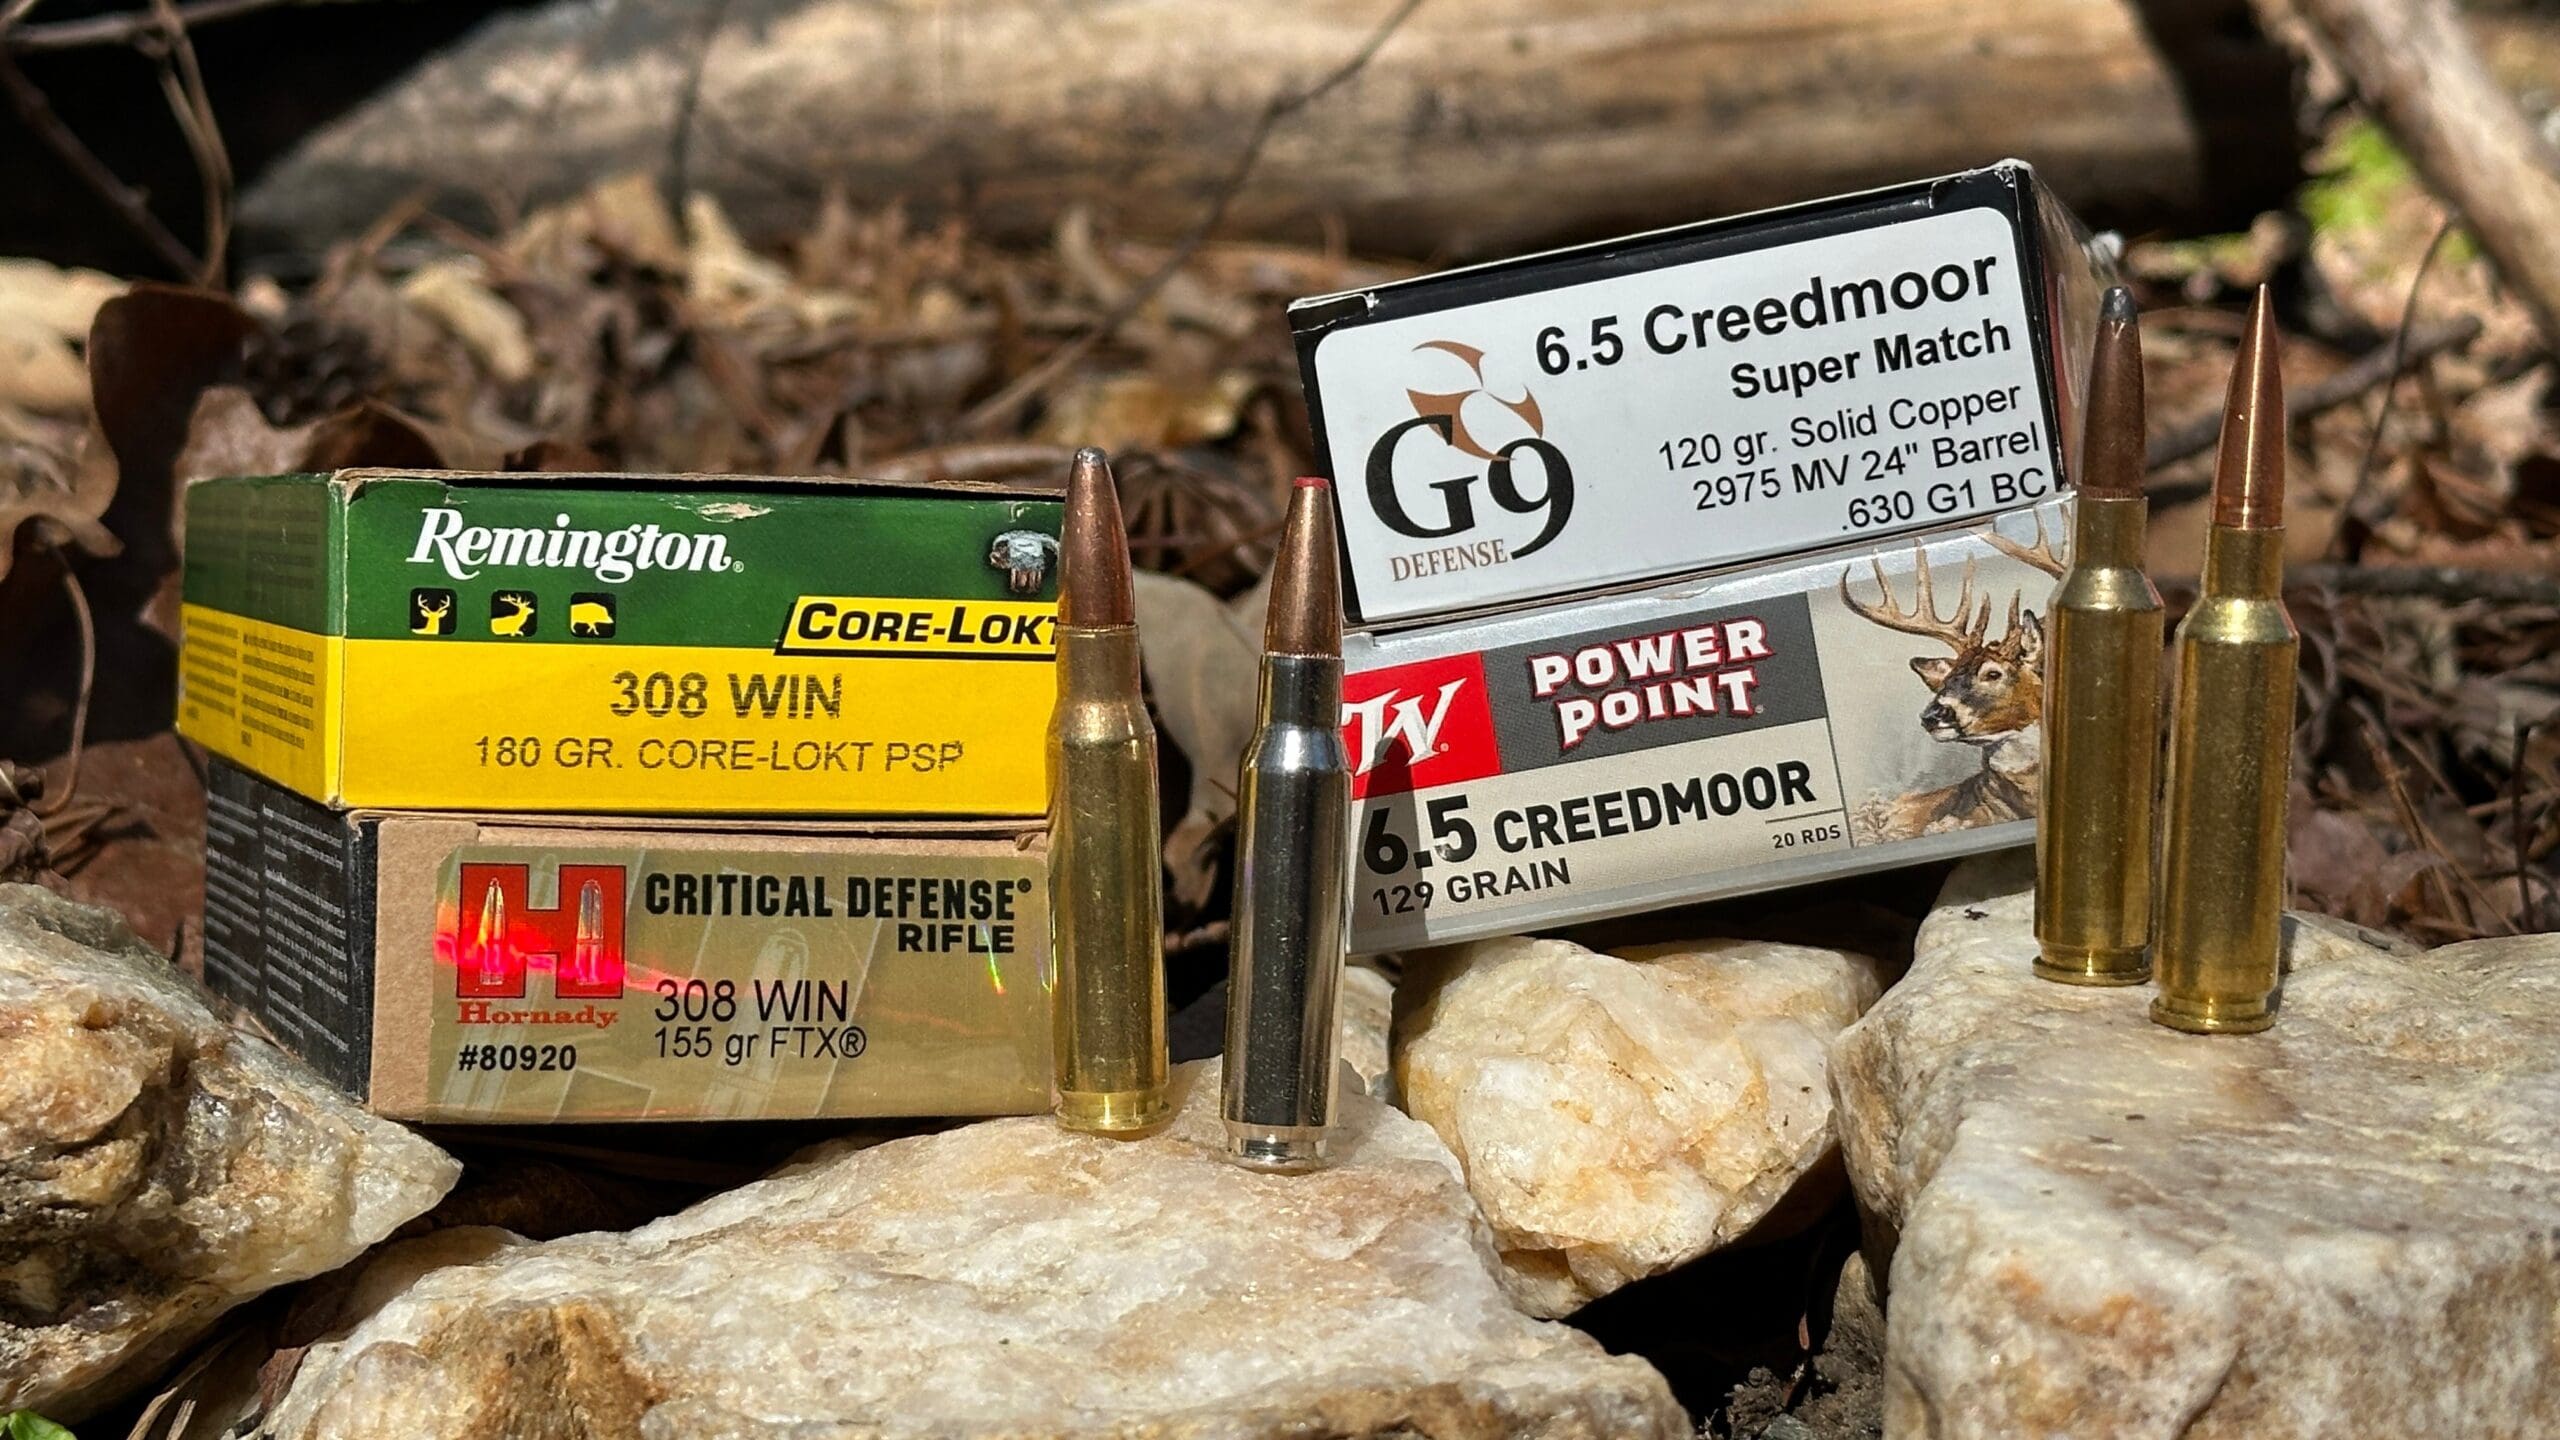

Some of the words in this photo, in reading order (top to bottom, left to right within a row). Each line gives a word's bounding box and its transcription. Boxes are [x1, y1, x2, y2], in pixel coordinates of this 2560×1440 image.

[1535, 315, 1624, 376] 6.5
[1643, 255, 1997, 355] Creedmoor
[1731, 350, 1860, 399] Super
[1873, 318, 2012, 373] Match
[1659, 433, 1721, 471] 120
[1733, 430, 1778, 466] gr.
[1790, 405, 1877, 447] Solid
[1889, 384, 2021, 430] Copper
[1365, 413, 1575, 560] G9
[1693, 468, 1781, 511] 2975
[1792, 455, 1849, 493] MV
[1861, 442, 1918, 481] 24"
[1932, 421, 2040, 468] Barrel
[1841, 491, 1914, 531] .630
[1927, 479, 1975, 514] G1
[1991, 467, 2047, 504] BC
[1390, 538, 1508, 582] DEFENSE
[1528, 616, 1776, 697] POWER
[609, 670, 708, 717] 308
[728, 672, 842, 719] WIN
[1556, 666, 1760, 750] POINT
[475, 735, 541, 768] 180
[553, 738, 623, 769] GR.
[638, 739, 873, 772] CORE-LOKT
[885, 740, 964, 772] PSP
[1363, 794, 1477, 876] 6.5
[1494, 759, 1817, 854] CREEDMOOR
[1772, 832, 1796, 850] 20
[1801, 824, 1842, 845] RDS
[645, 873, 833, 917] CRITICAL
[1372, 880, 1434, 917] 129
[1446, 858, 1572, 903] GRAIN
[898, 923, 1015, 953] RIFLE
[456, 1001, 618, 1029] Hornady
[655, 979, 737, 1022] 308
[754, 979, 848, 1022] WIN
[458, 1044, 577, 1072] #80920
[654, 1026, 712, 1058] 155
[726, 1032, 759, 1065] gr
